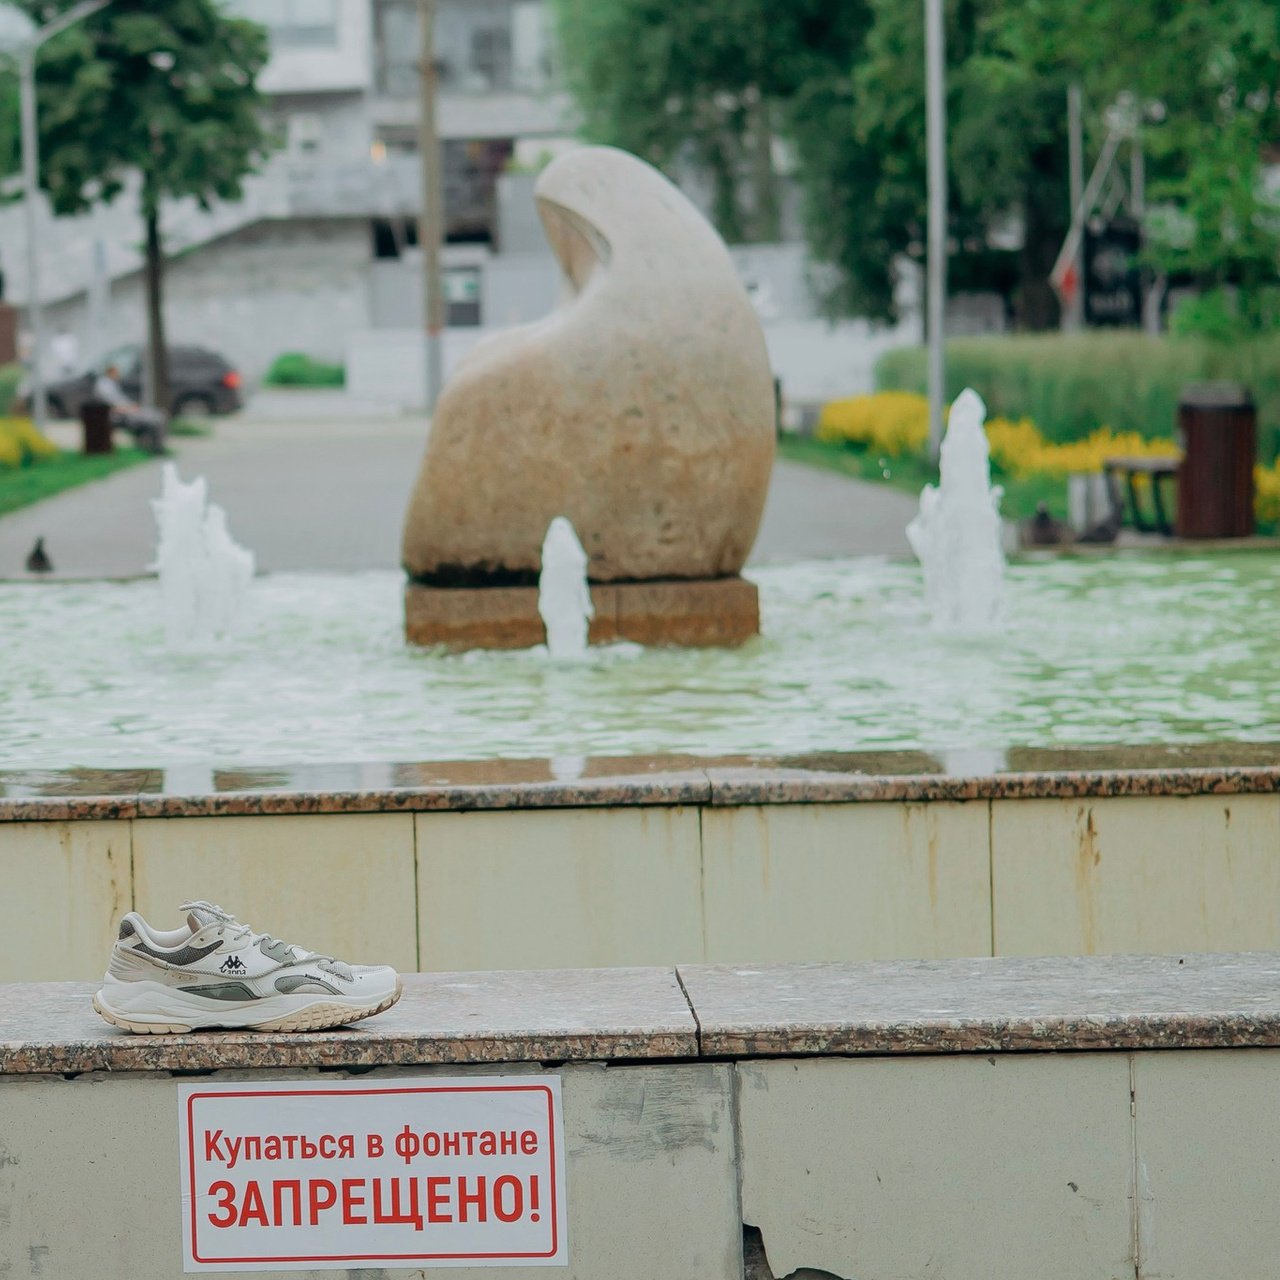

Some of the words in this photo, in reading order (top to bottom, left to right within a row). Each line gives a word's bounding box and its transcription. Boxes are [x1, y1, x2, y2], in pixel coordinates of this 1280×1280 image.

[205, 1130, 355, 1168] Купаться
[367, 1134, 384, 1158] в
[395, 1125, 538, 1164] фонтане
[207, 1175, 540, 1231] ЗАПРЕЩЕНО!
